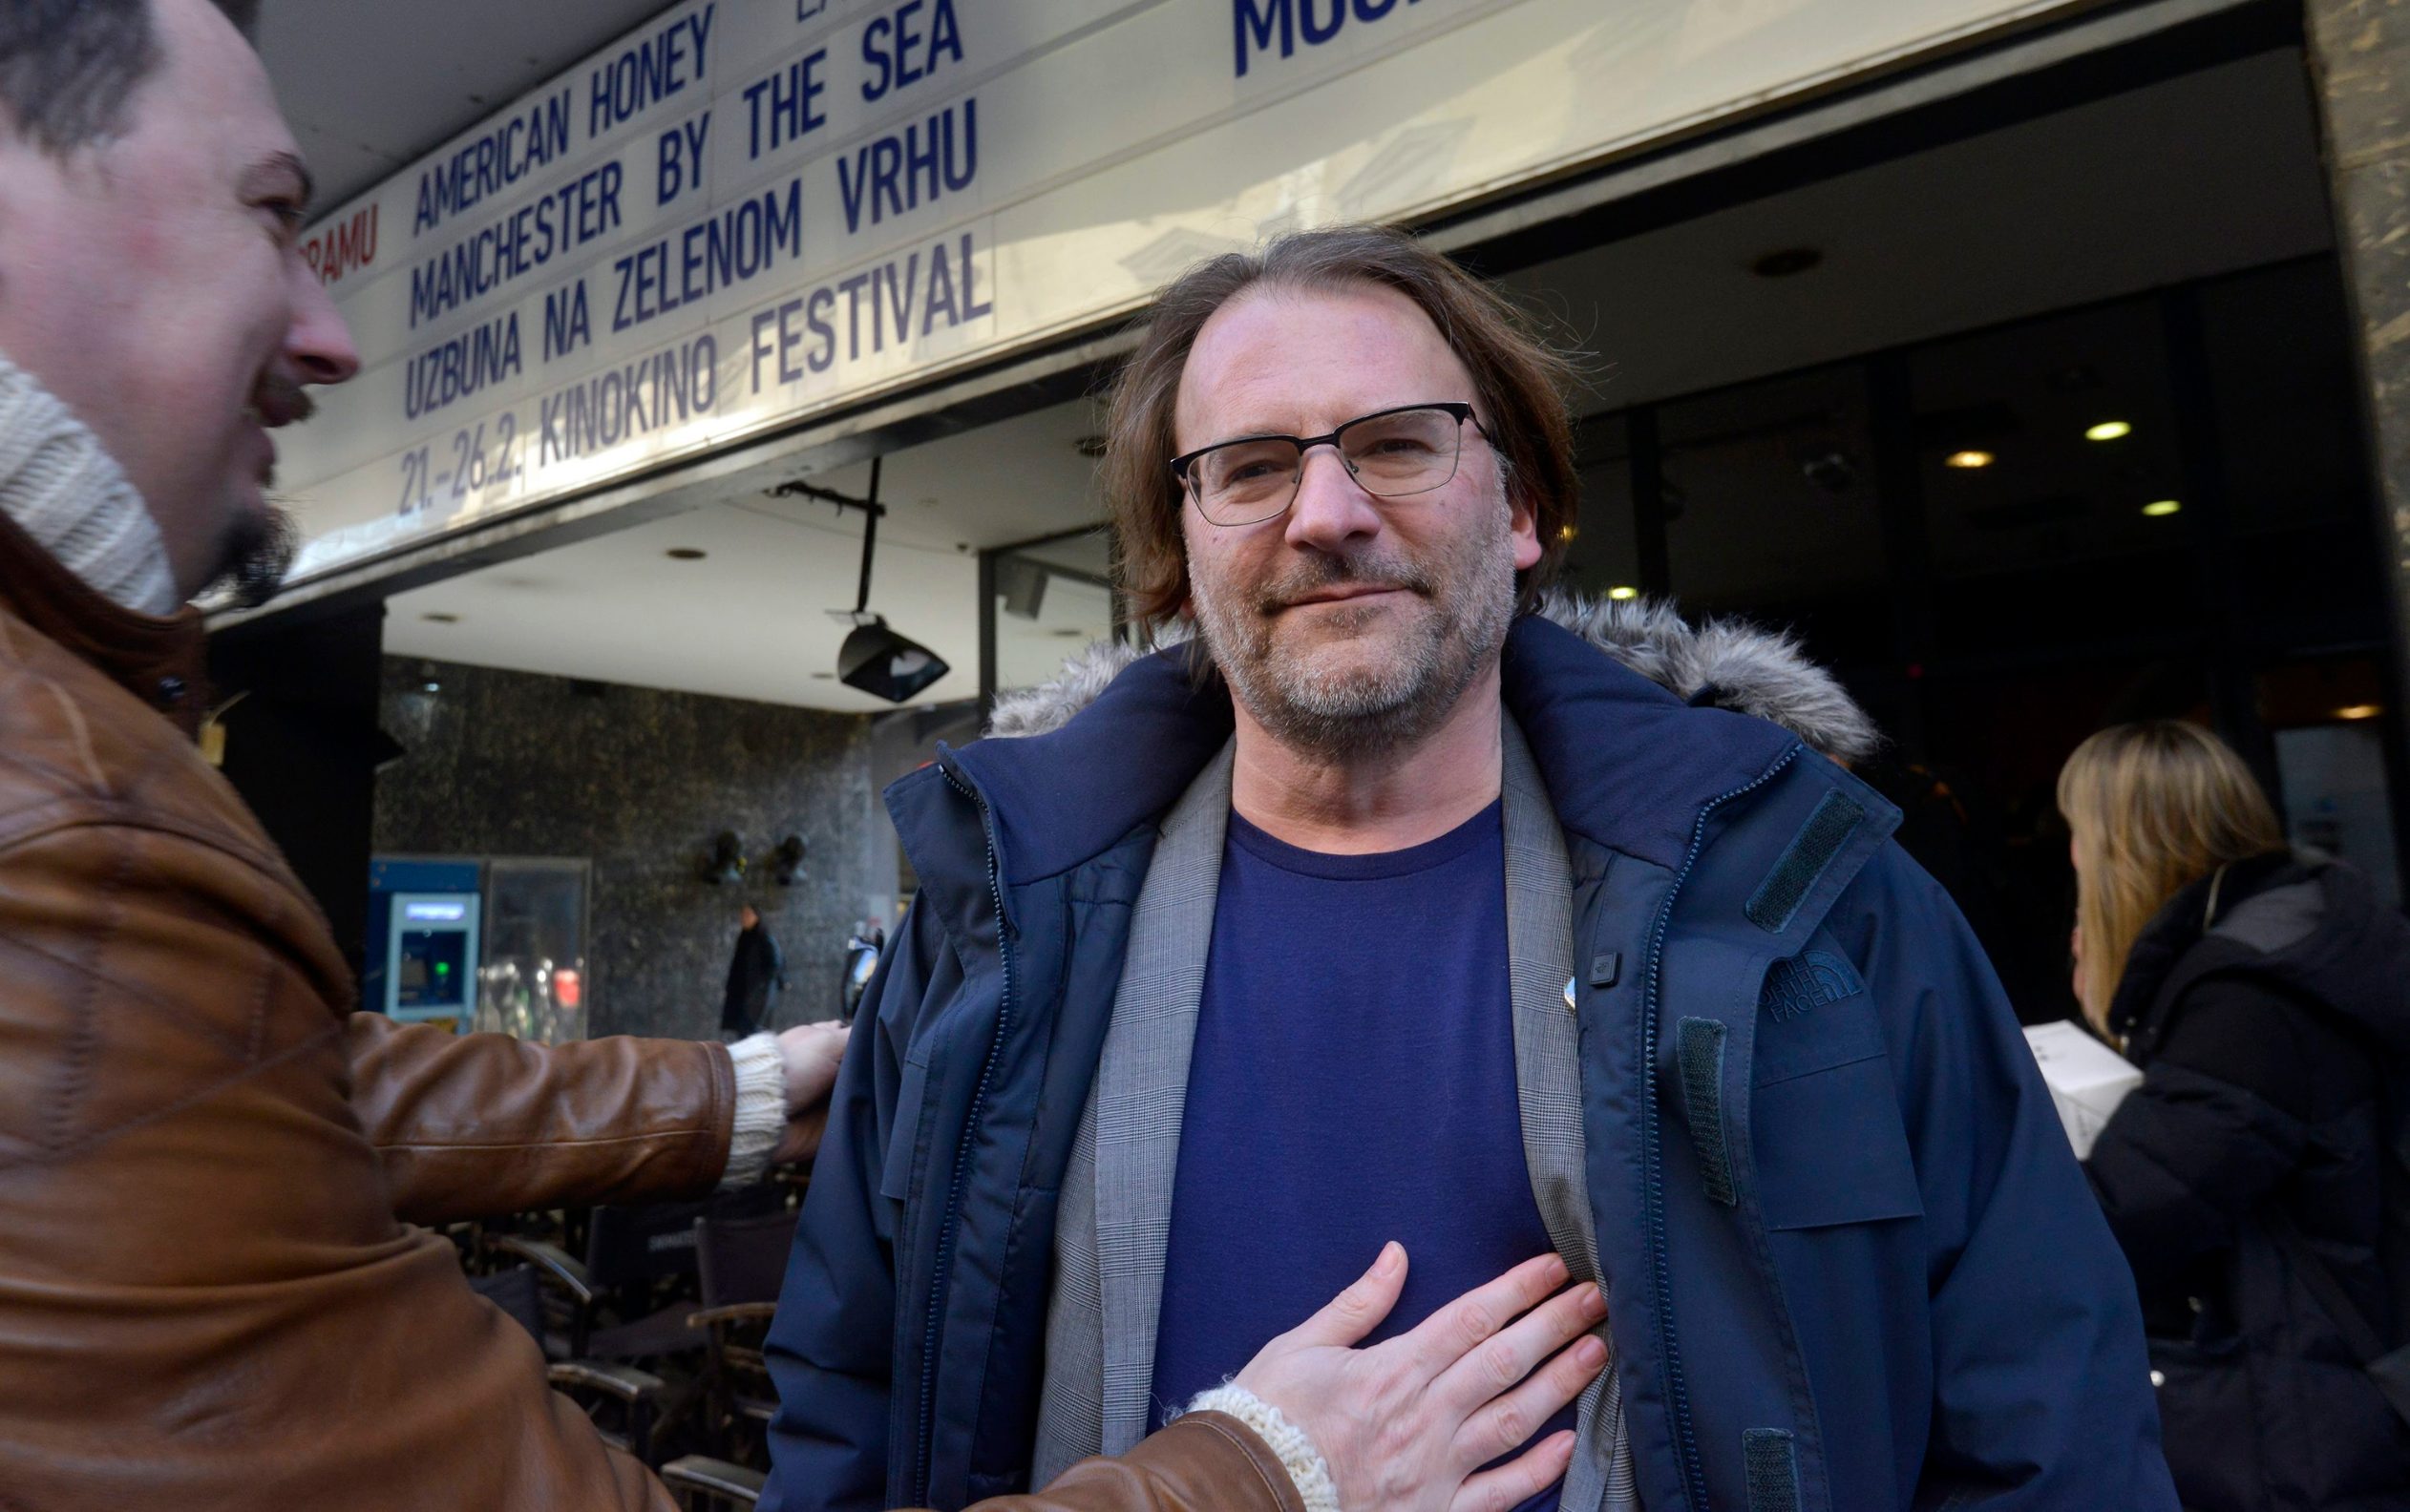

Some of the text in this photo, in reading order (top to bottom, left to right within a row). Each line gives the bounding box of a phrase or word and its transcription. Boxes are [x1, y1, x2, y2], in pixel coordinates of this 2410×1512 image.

[411, 0, 963, 330] MANCHESTER BY THE SEA
[412, 2, 714, 238] AMERICAN HONEY
[406, 97, 977, 420] UZBUNA NA ZELENOM VRHU
[540, 334, 717, 468] KINOKINO
[752, 233, 992, 394] FESTIVAL
[1770, 987, 1829, 1023] FACE
